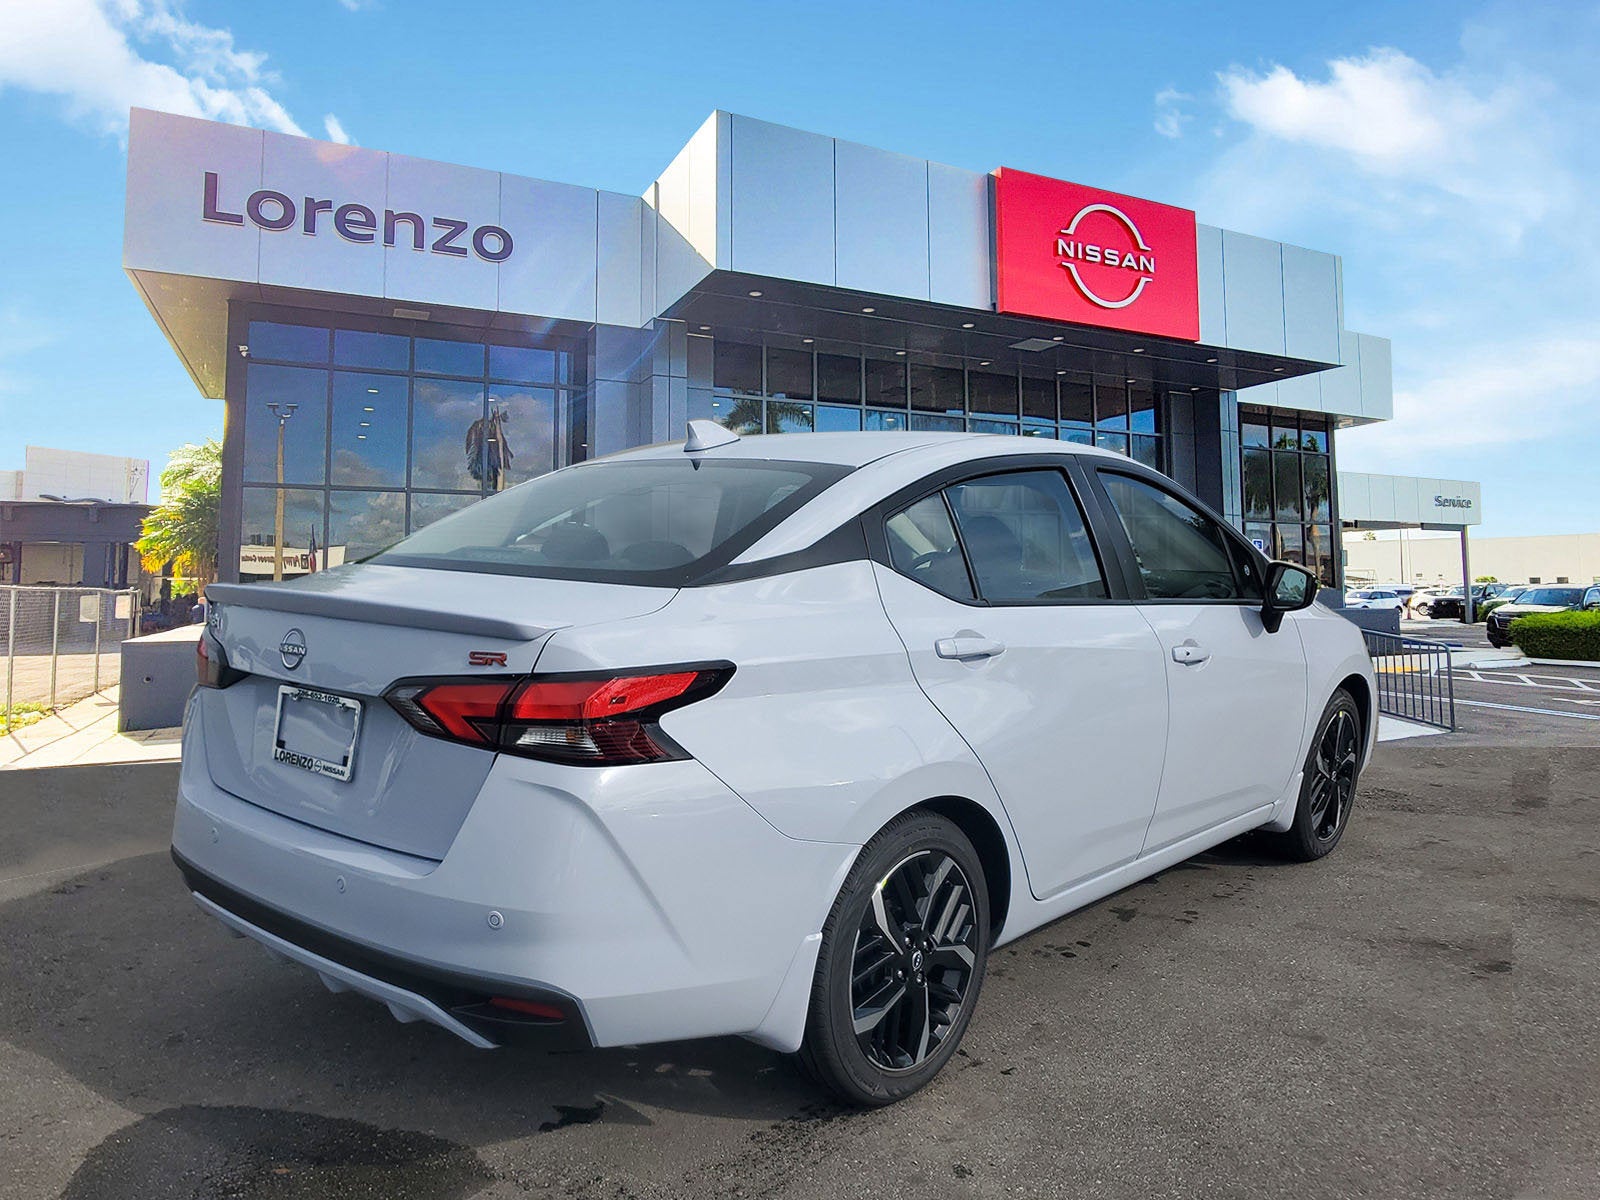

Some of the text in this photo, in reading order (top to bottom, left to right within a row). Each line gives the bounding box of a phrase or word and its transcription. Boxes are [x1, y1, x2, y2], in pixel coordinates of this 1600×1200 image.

[203, 171, 514, 262] Lorenzo
[1056, 238, 1156, 274] NISSAN
[1434, 495, 1472, 509] Service
[469, 651, 507, 667] SR
[274, 748, 346, 777] LORENZO NISSAN
